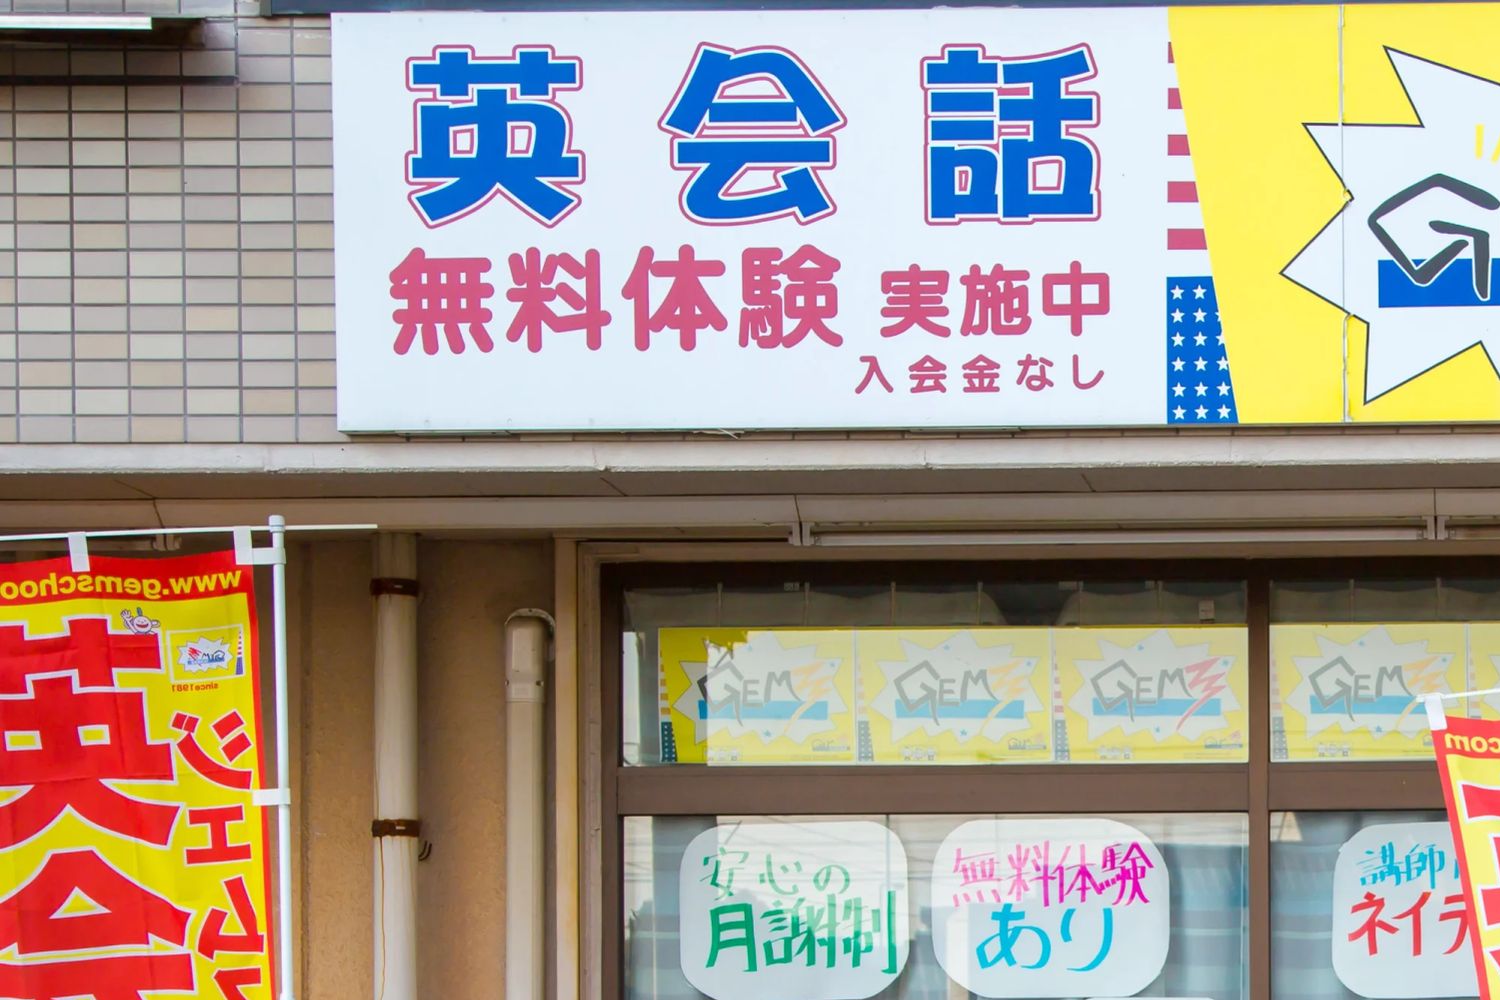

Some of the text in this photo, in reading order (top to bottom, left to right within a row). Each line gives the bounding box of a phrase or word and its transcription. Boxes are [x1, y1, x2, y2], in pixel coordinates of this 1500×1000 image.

[405, 42, 1102, 228] 英会話
[389, 243, 1111, 356] 無料体験 実施中
[854, 354, 1106, 395] 入会金なし
[894, 659, 1003, 726] GEM
[1091, 658, 1195, 725] GEM
[700, 846, 851, 900] 安心の
[952, 840, 1156, 908] 無料体験
[1356, 841, 1460, 890] 講師
[705, 890, 898, 975] 月謝制
[975, 903, 1114, 973] あり
